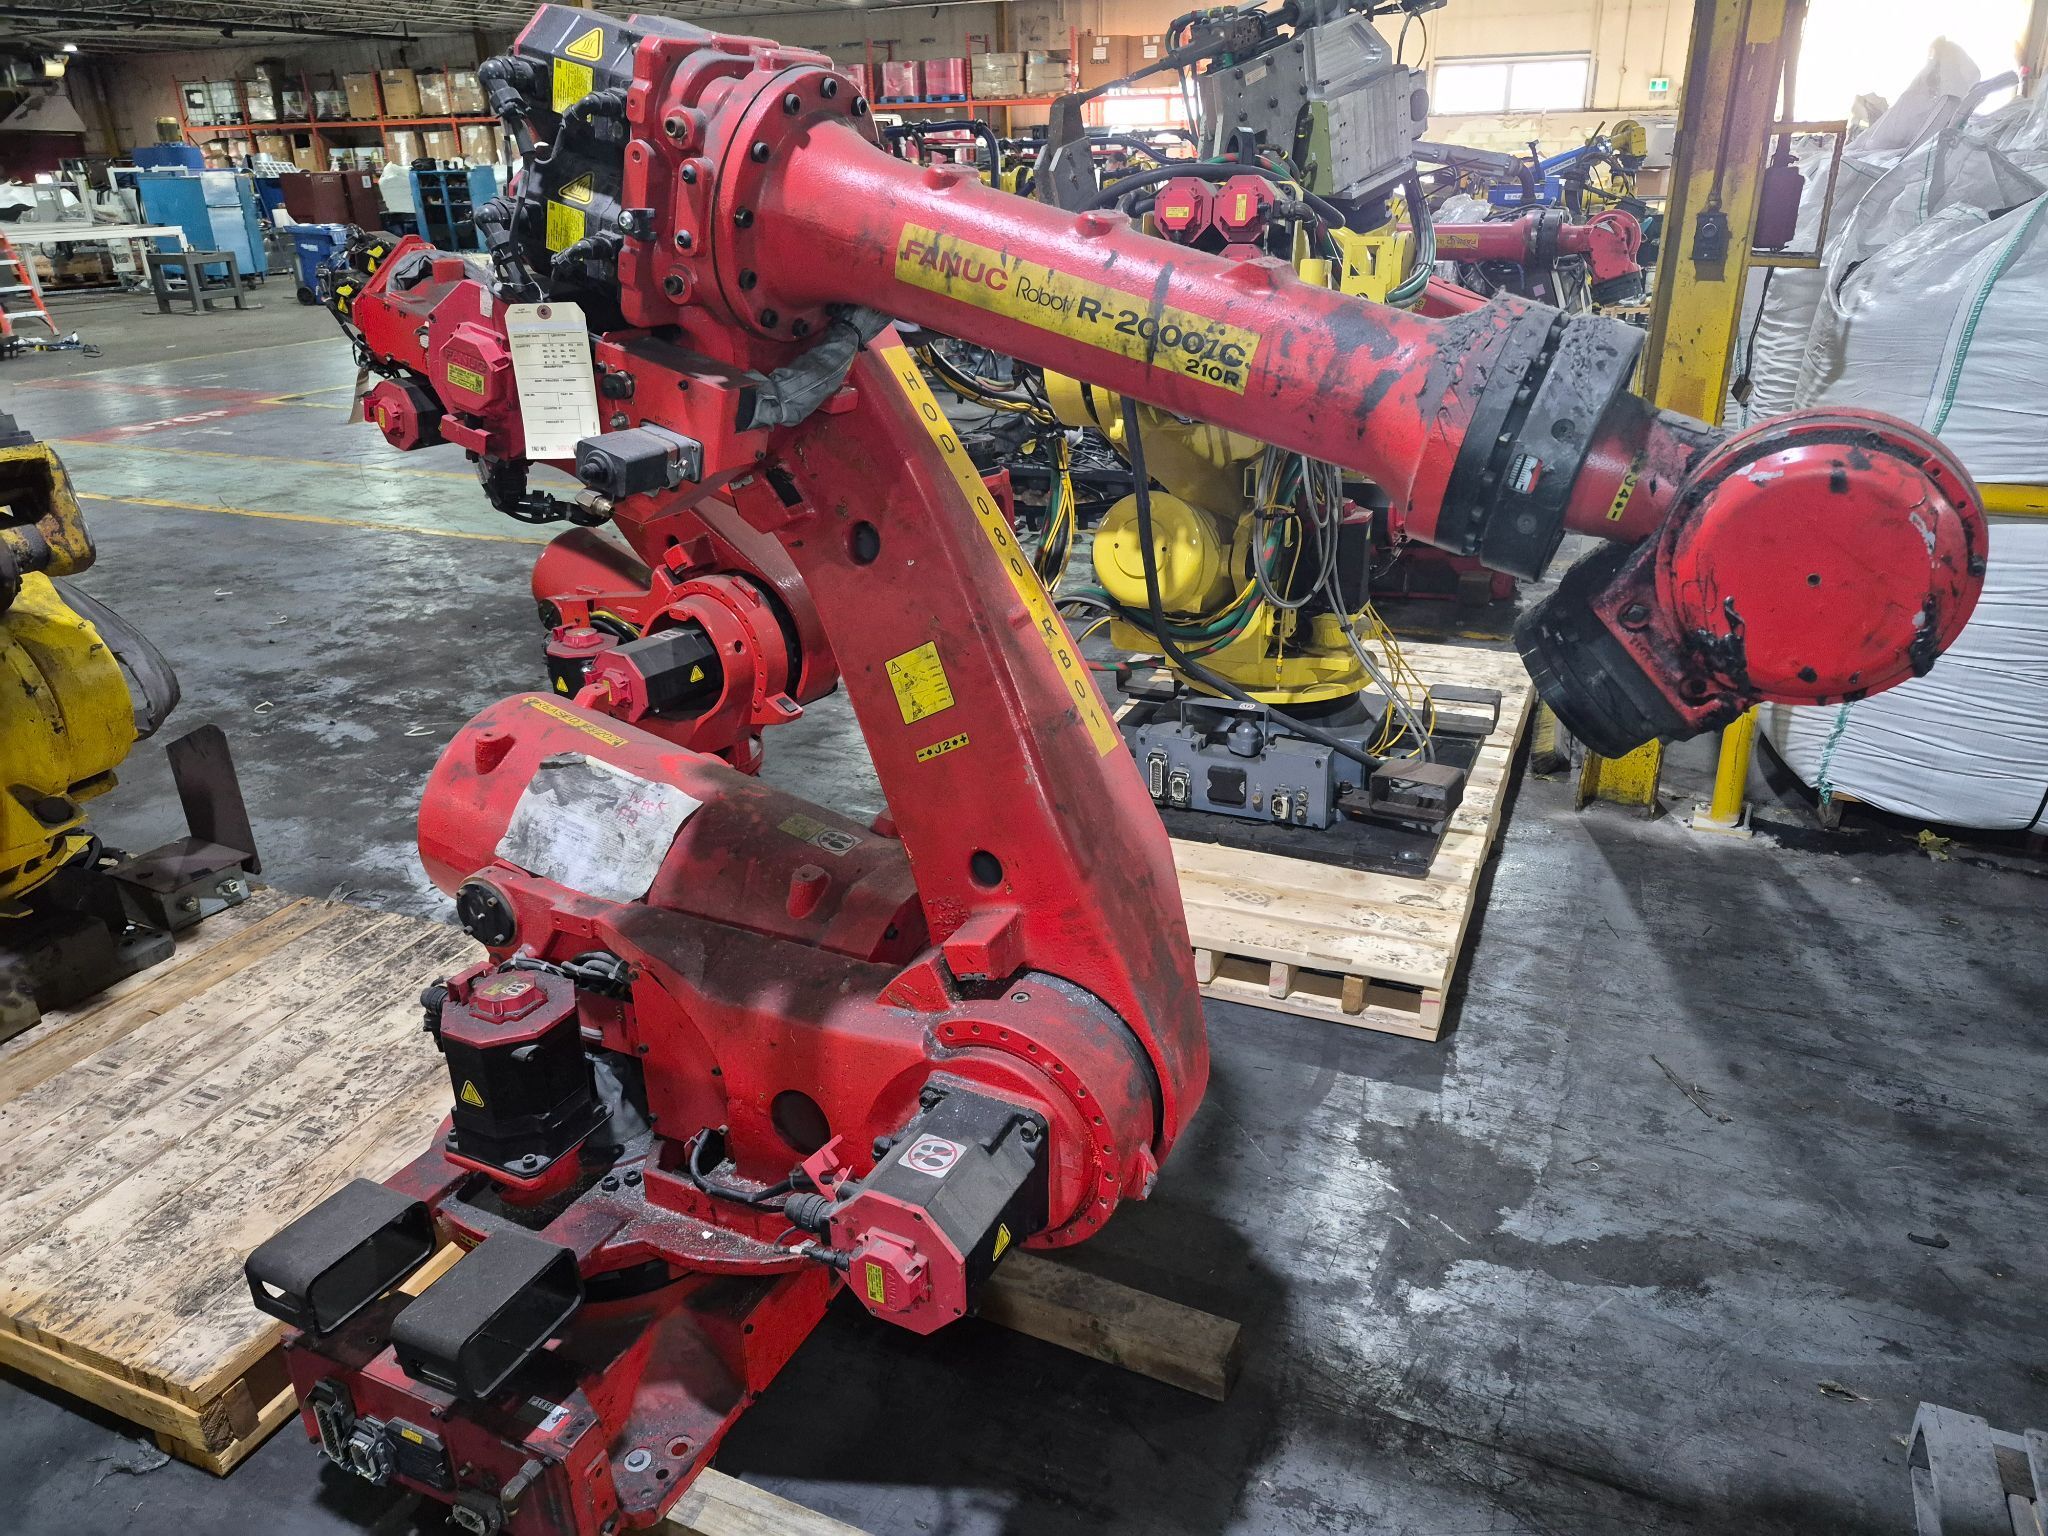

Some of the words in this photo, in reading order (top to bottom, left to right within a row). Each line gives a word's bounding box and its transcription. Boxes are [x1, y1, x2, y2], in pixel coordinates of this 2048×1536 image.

[903, 240, 1009, 291] FANUC
[1016, 276, 1074, 313] Robot
[1185, 358, 1239, 388] 210R
